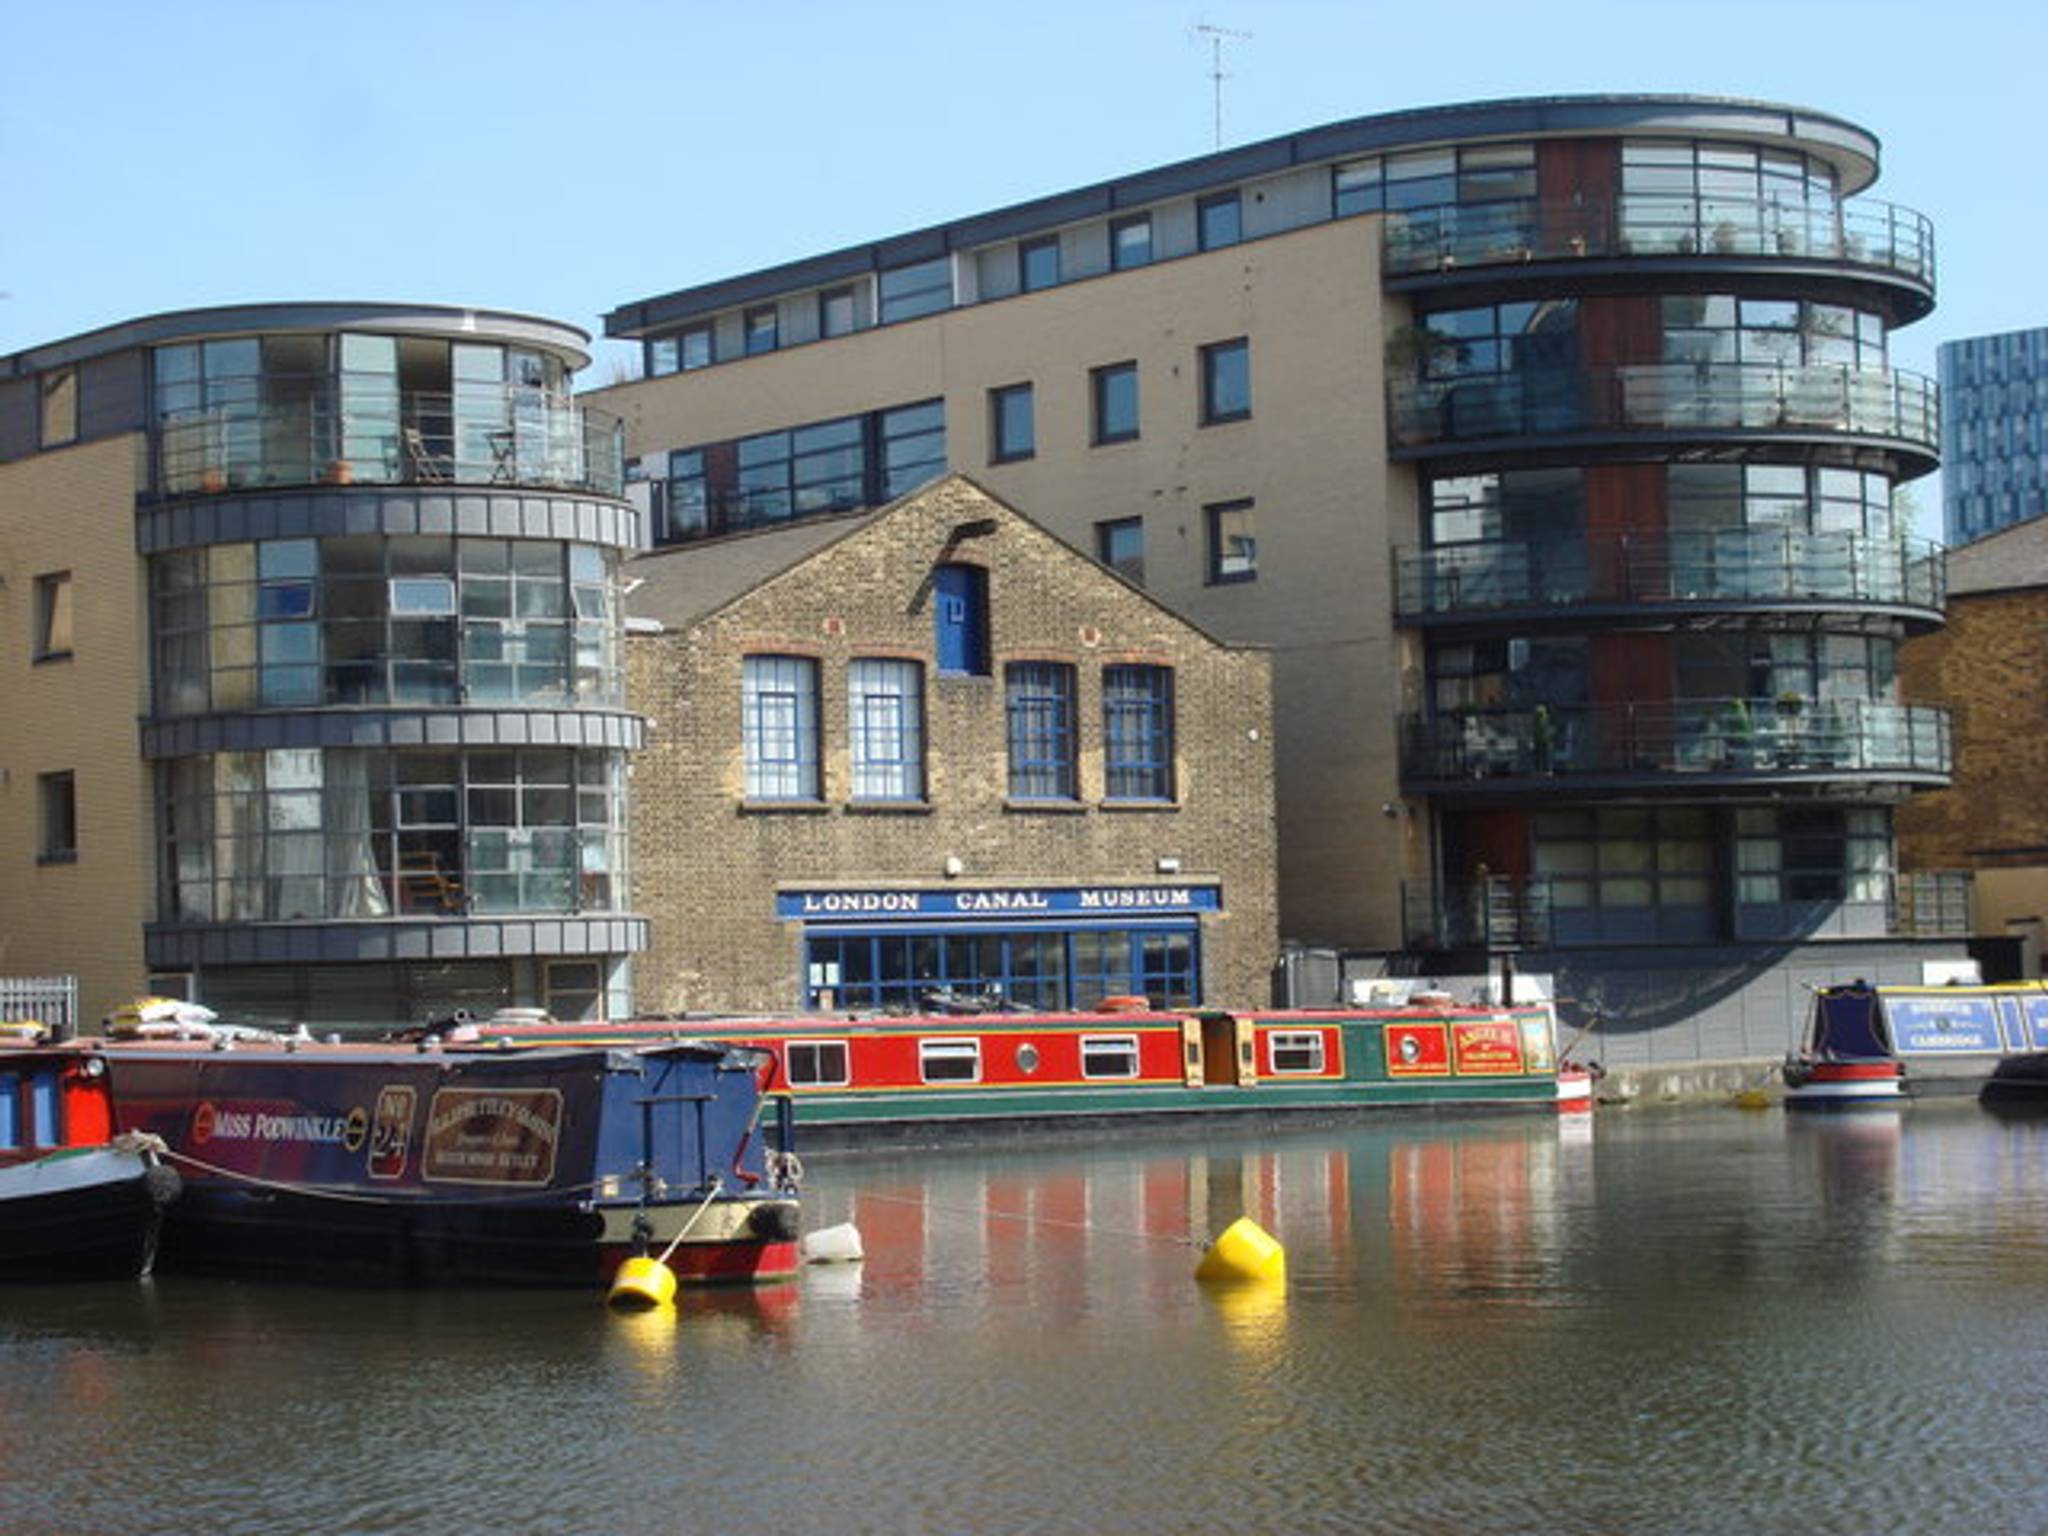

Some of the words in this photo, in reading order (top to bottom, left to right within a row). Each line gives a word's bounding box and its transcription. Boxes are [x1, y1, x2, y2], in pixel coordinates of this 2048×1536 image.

[803, 893, 919, 911] LONDON
[956, 891, 1048, 909] CANAL
[1079, 889, 1190, 907] MUSEUM
[214, 1112, 250, 1138] MISS
